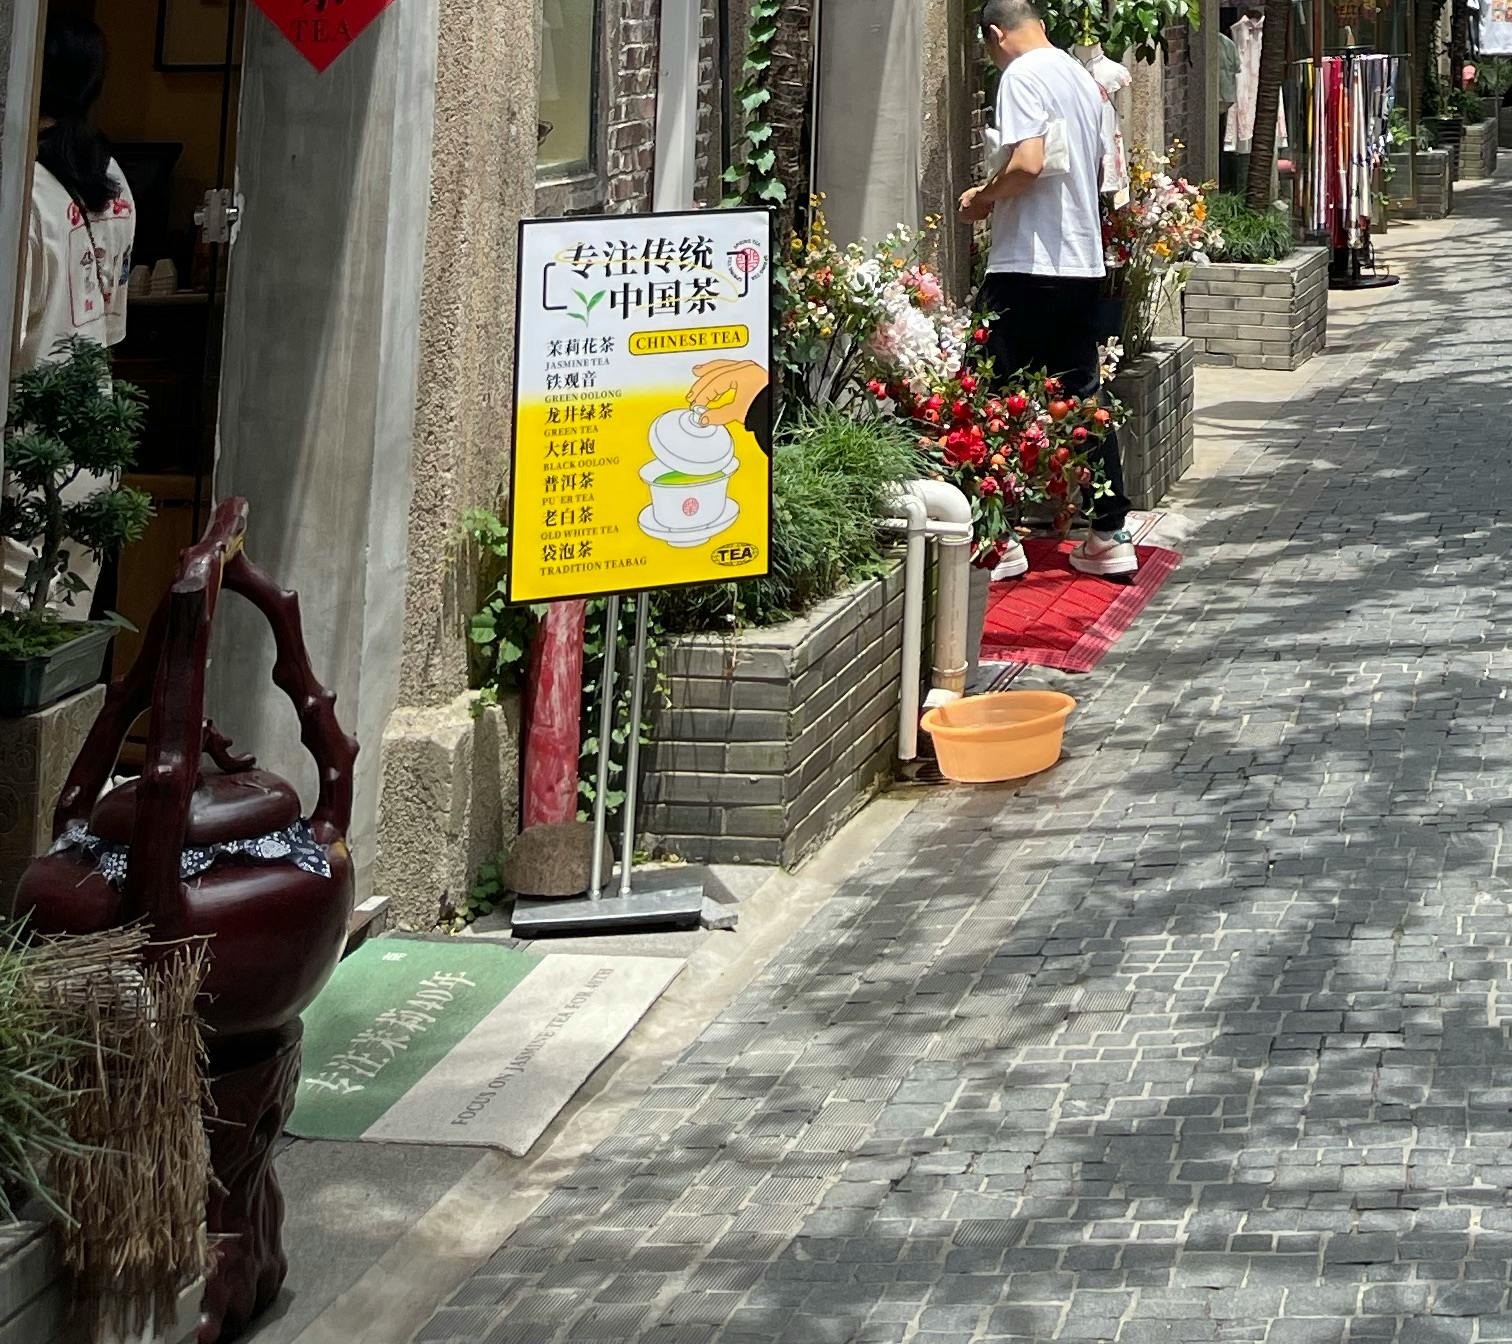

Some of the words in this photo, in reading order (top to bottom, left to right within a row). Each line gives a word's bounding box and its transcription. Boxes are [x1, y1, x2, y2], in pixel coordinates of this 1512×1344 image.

[290, 18, 352, 43] TEA
[565, 235, 715, 280] 专注传统
[610, 276, 720, 320] 中国茶
[544, 336, 616, 357] 茉莉花茶
[636, 333, 708, 350] CHINESE
[712, 330, 742, 345] TEA
[545, 358, 590, 371] JASMINE
[591, 357, 610, 366] TEA
[546, 370, 597, 390] 铁观音
[544, 393, 578, 404] GREEN
[580, 389, 622, 401] OOLONG
[544, 402, 614, 425] 龙井绿茶
[544, 426, 577, 438] GREEN
[580, 424, 599, 434] TEA
[543, 438, 596, 459] 大红袍
[543, 460, 576, 472] BLACK
[578, 456, 620, 468] OOLONG
[544, 471, 595, 493] 普洱茶
[575, 493, 595, 503] TEA
[544, 505, 593, 528] 老白茶
[540, 531, 561, 541] OLD
[564, 527, 599, 538] WHITE
[600, 525, 619, 535] TEA
[542, 540, 593, 562] 袋泡茶
[717, 547, 753, 562] TEA
[540, 561, 601, 576] TRADITION
[603, 556, 647, 570] TEABAG
[450, 1091, 497, 1126] FOCUS
[488, 1072, 515, 1089] ON
[504, 1030, 556, 1073] JASMINE
[550, 1010, 575, 1029] TEA
[565, 991, 591, 1010] FOR
